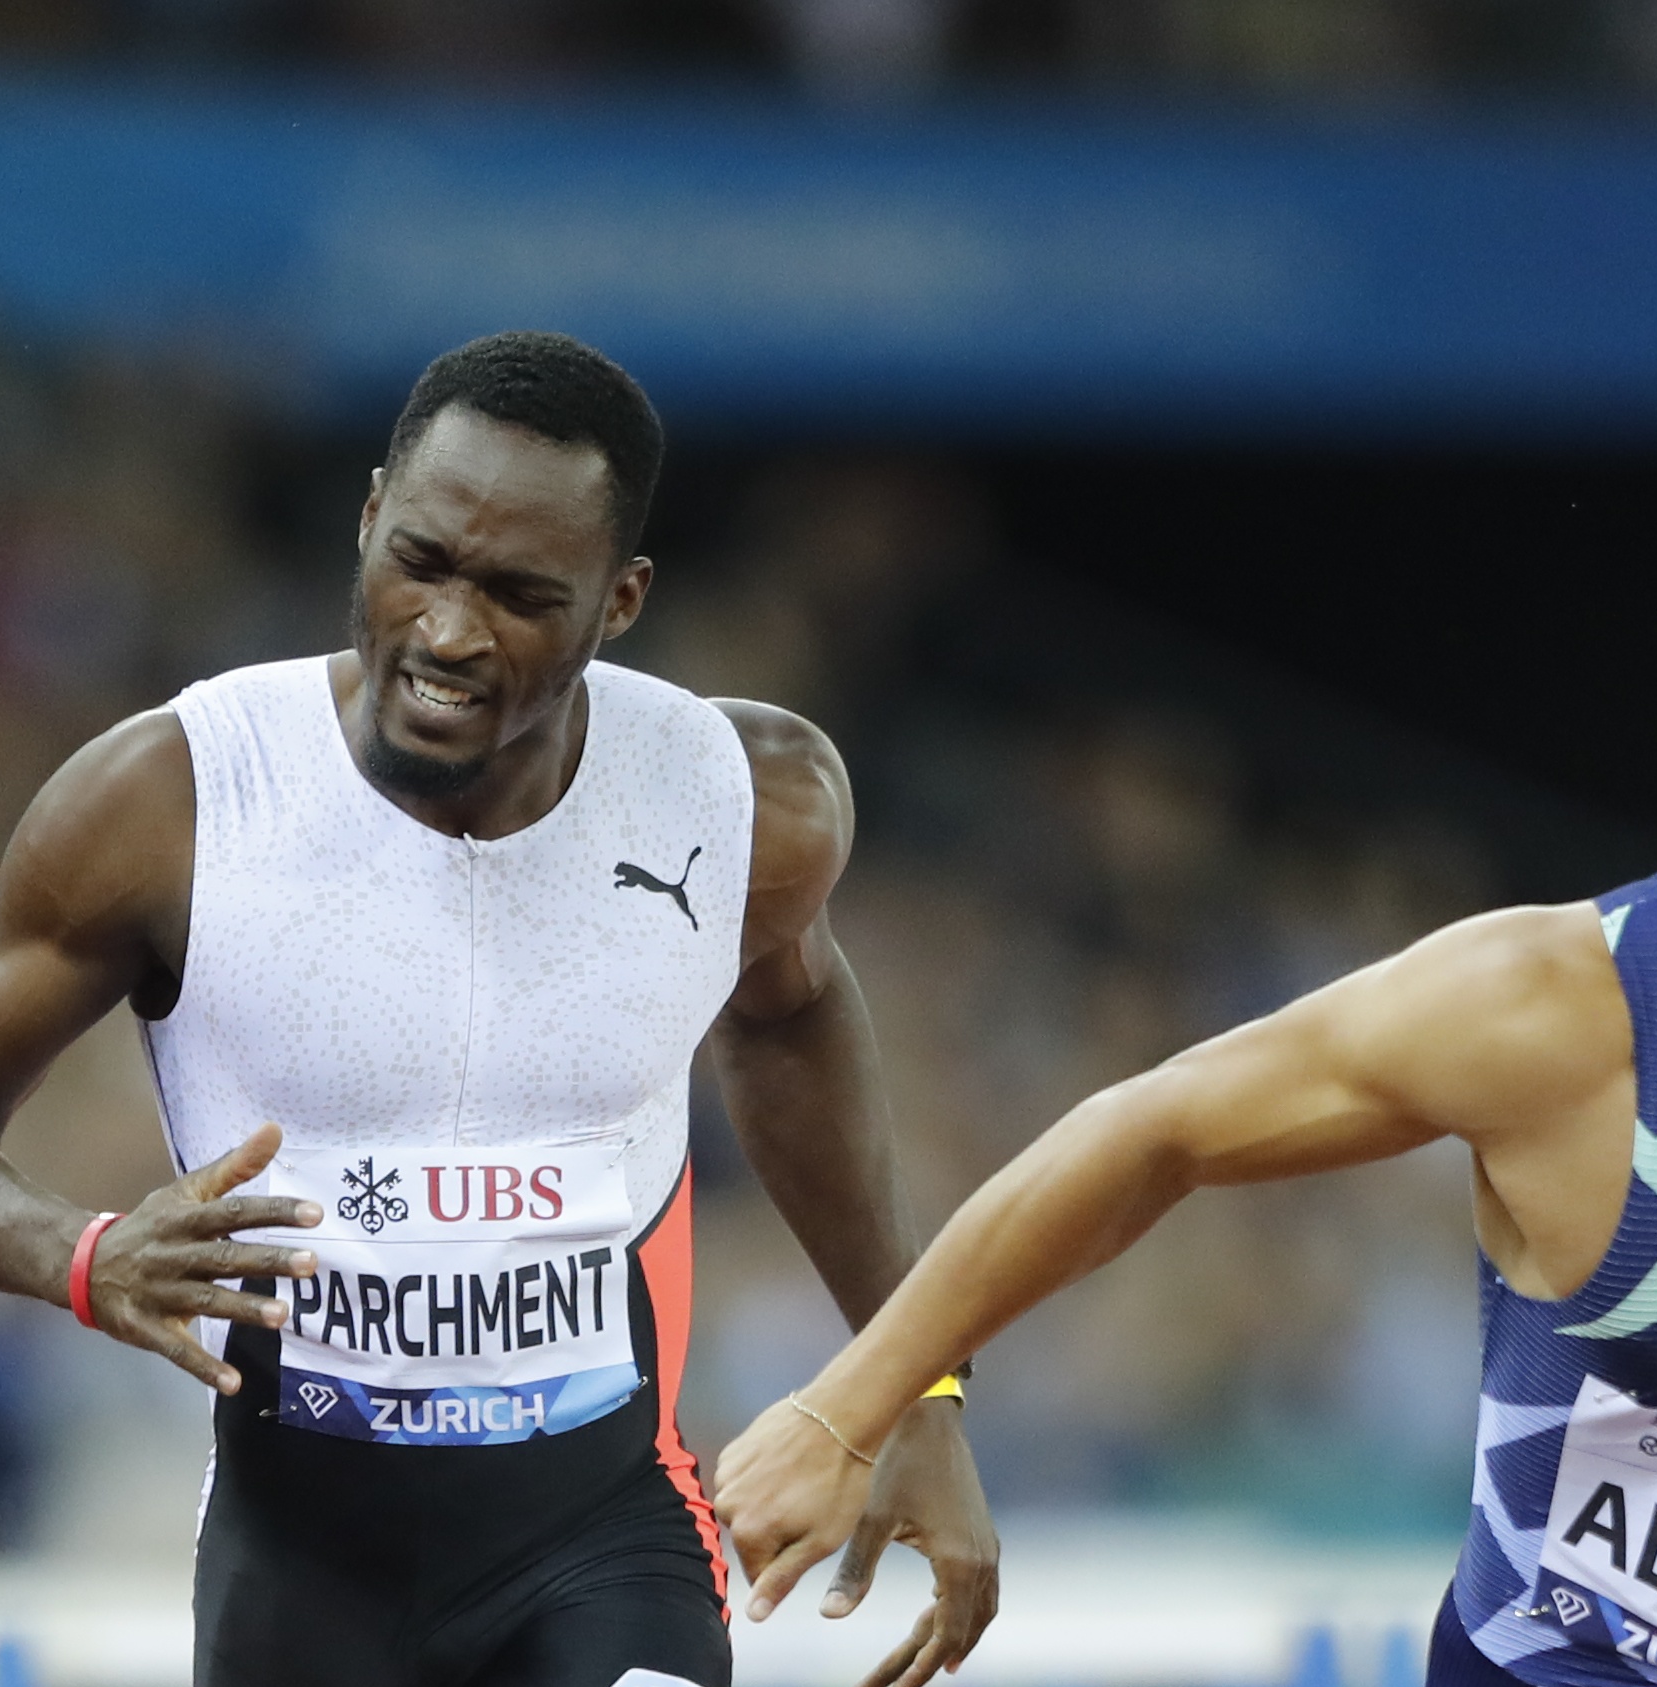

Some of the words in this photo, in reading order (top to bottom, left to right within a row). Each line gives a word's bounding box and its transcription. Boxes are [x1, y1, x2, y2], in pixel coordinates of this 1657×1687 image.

[421, 1165, 563, 1222] UBS
[292, 1246, 613, 1357] PARCHMENT
[369, 1393, 545, 1435] ZURICH
